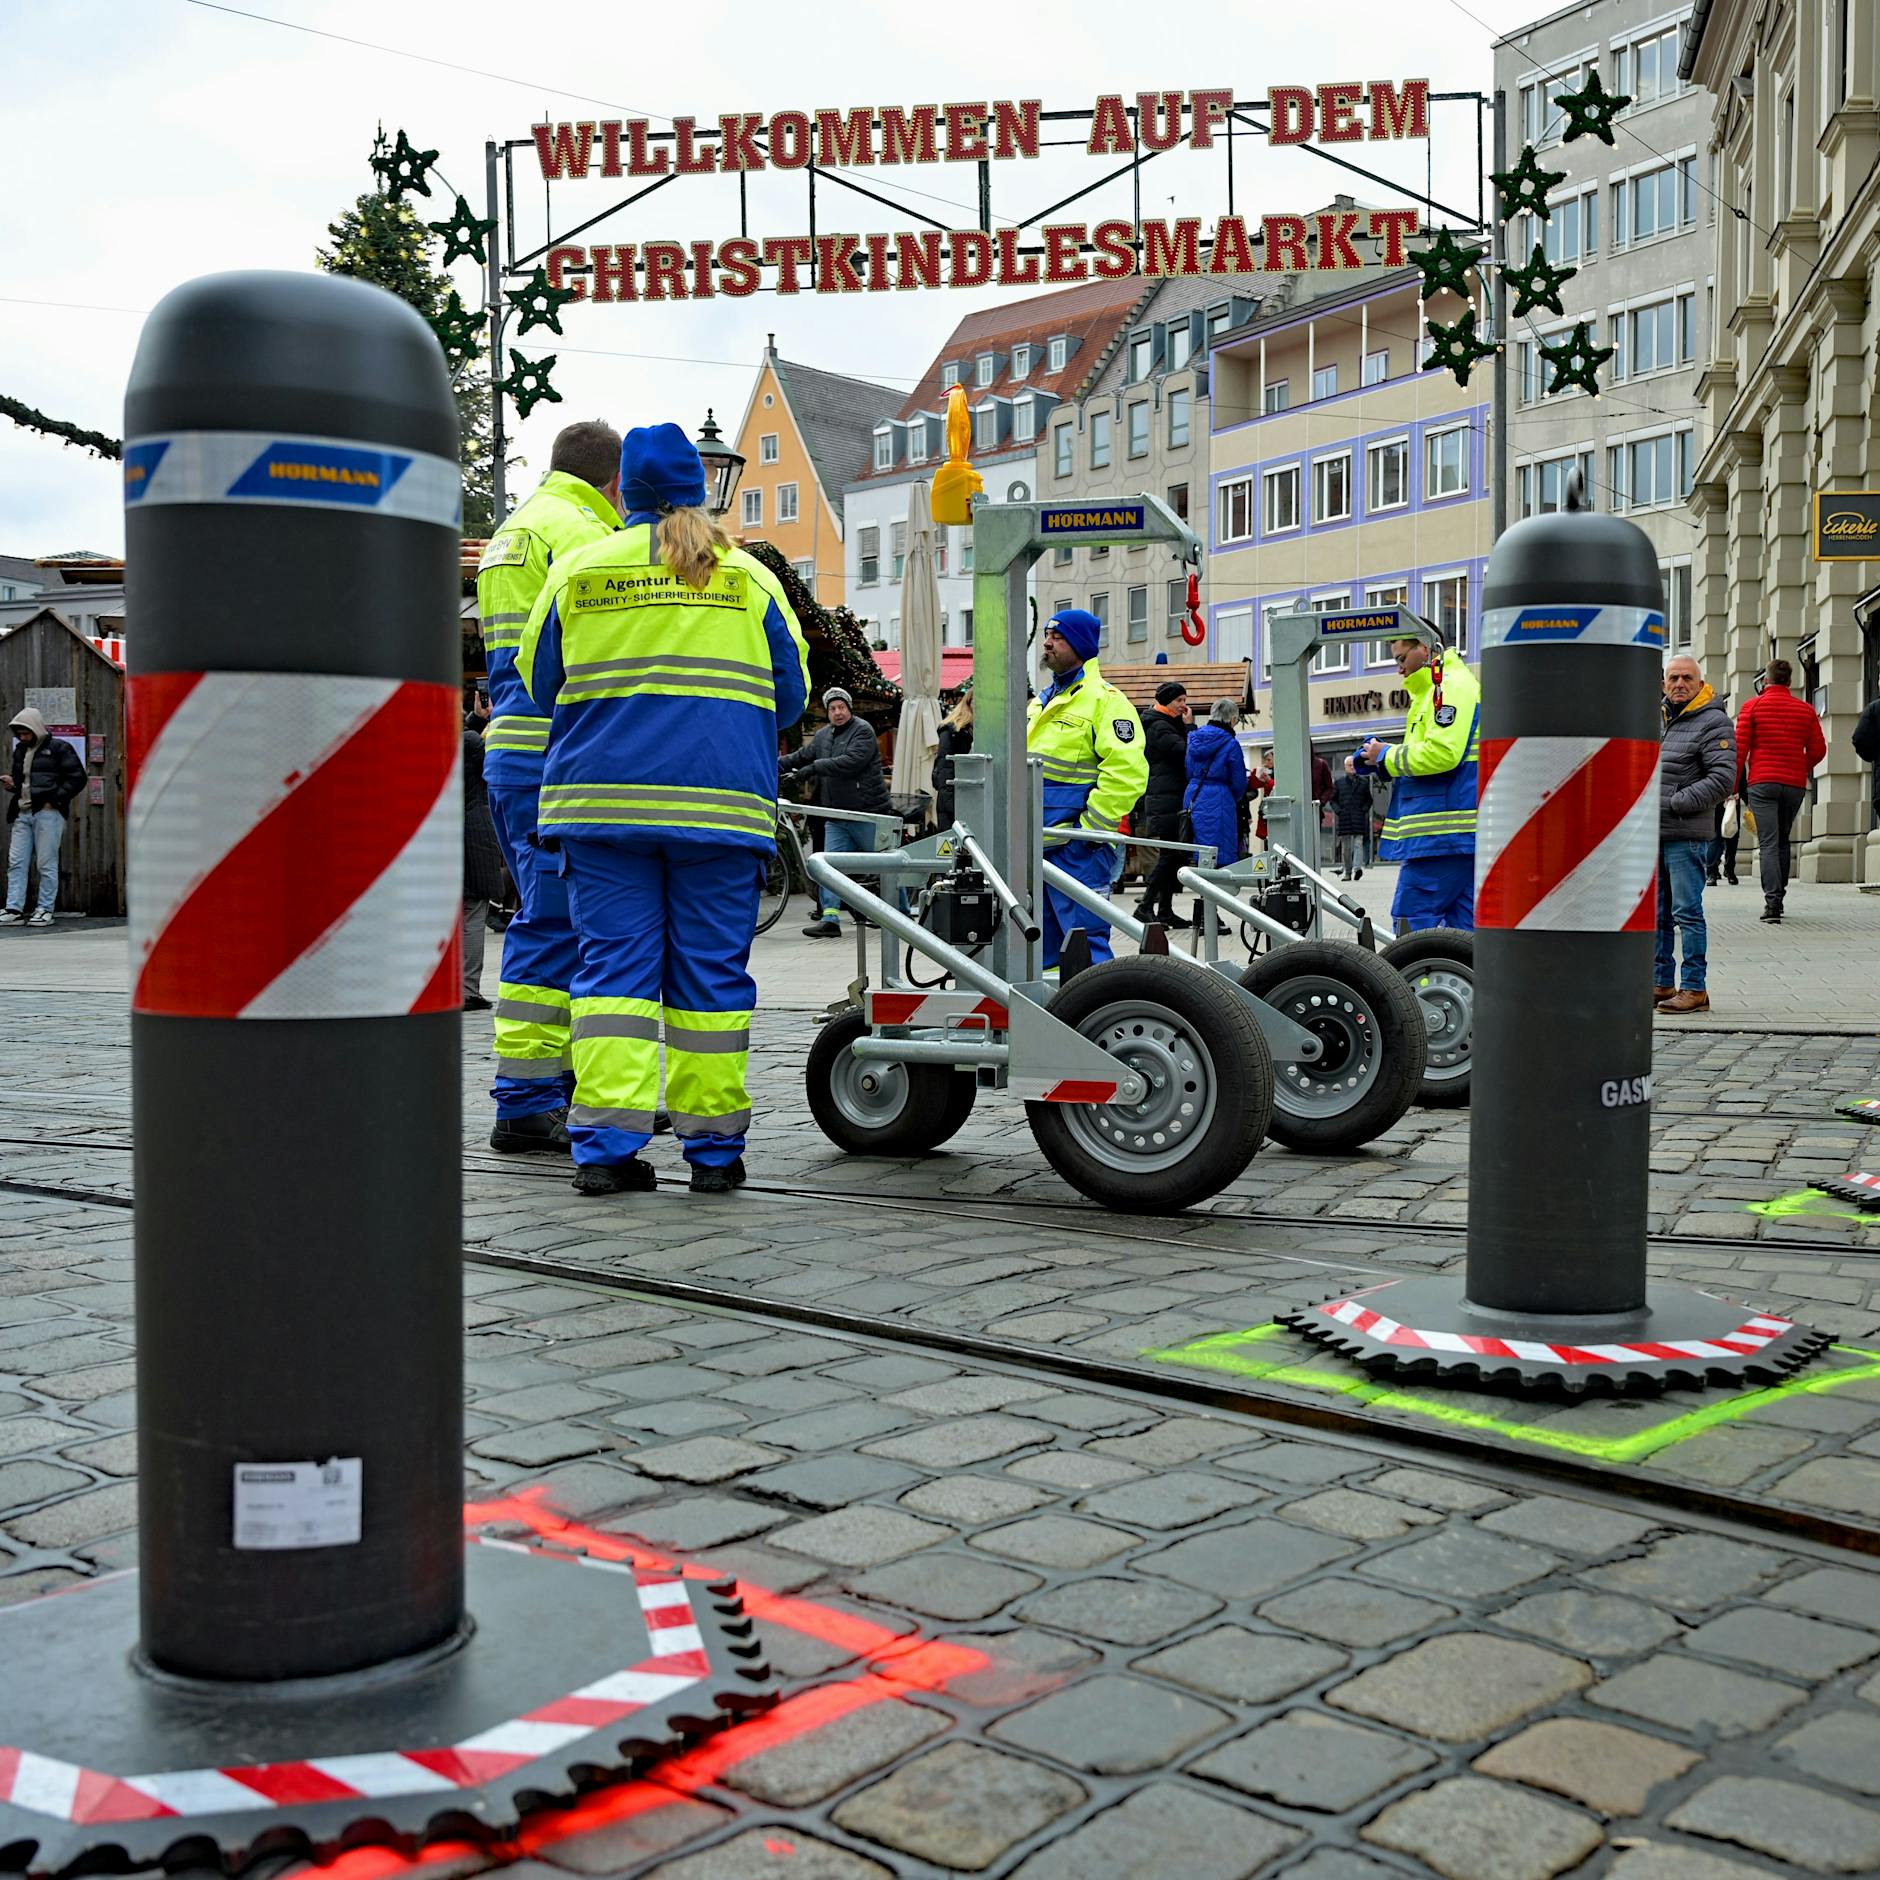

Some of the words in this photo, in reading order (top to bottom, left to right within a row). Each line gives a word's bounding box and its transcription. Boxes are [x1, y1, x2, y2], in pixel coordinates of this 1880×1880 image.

[531, 99, 1042, 180] WILLKOMMEN
[1087, 87, 1234, 155] AUF
[1267, 77, 1431, 146] DEM
[545, 207, 1420, 304] CHRISTKINDLESMARKT
[1822, 511, 1879, 535] Eckerle
[605, 575, 671, 592] Agentur
[1323, 690, 1382, 716] HENRY'S
